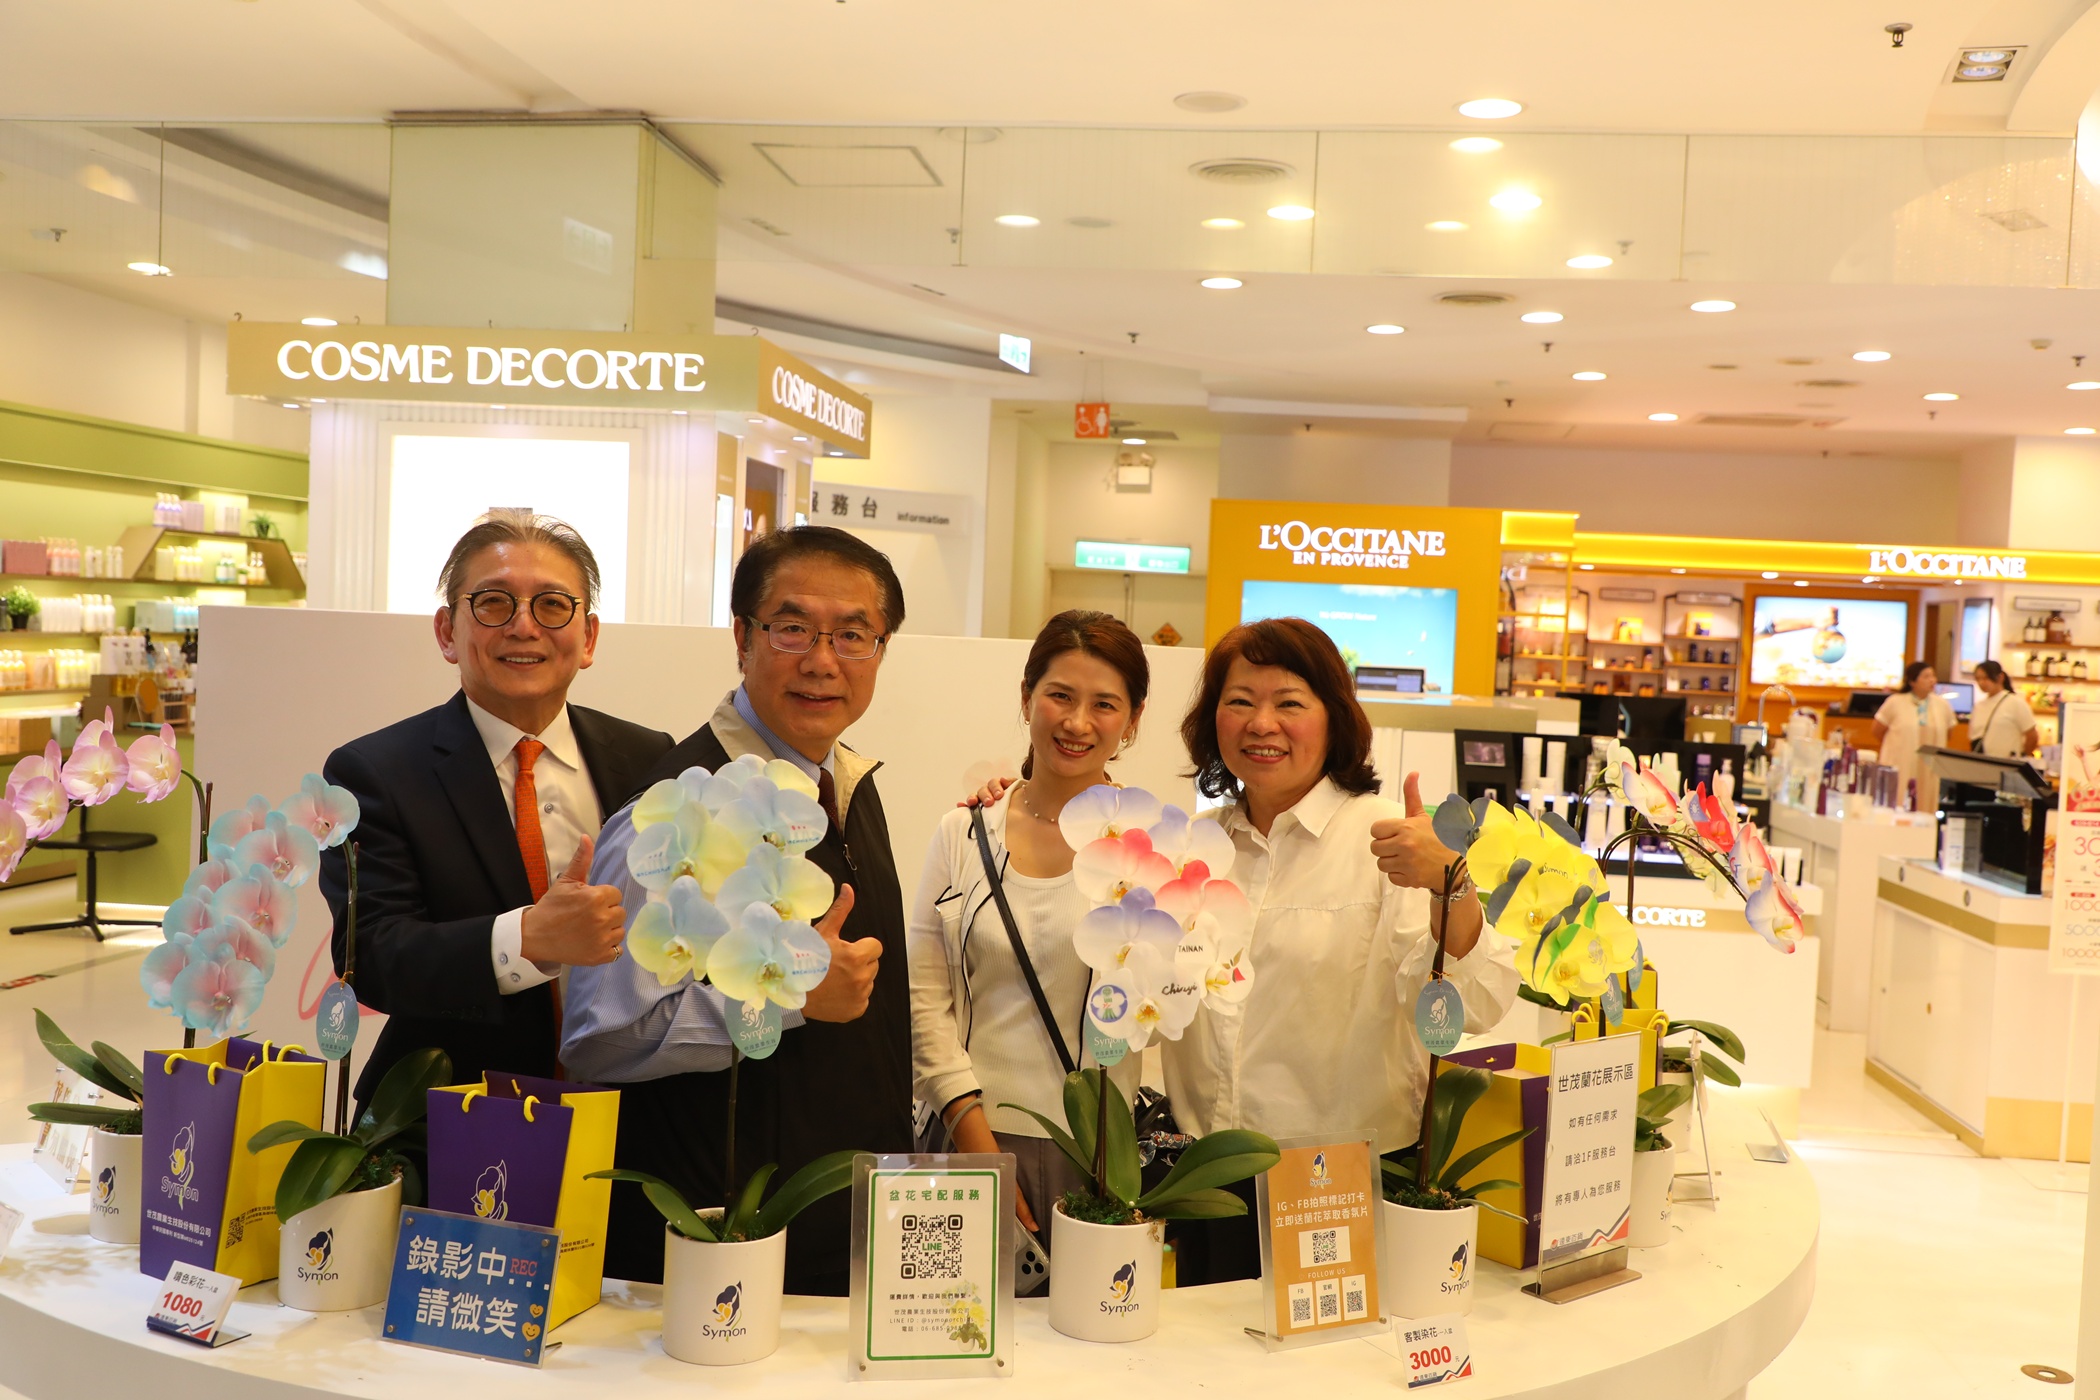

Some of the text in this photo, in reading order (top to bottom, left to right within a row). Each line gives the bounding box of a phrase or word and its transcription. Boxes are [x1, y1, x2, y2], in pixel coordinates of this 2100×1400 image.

[277, 340, 706, 392] COSME DECORTE
[772, 366, 865, 442] COSME DECORTE
[897, 511, 949, 525] information
[1259, 521, 1446, 556] L'OCCITANE
[1293, 551, 1409, 569] EN PROVENCE
[1869, 548, 2026, 578] L'OCCITANE
[322, 1028, 348, 1041] Symon
[740, 1026, 774, 1040] Symon
[1425, 1026, 1455, 1037] Symon
[1558, 1063, 1634, 1093] 世茂蘭花展示區
[1569, 1109, 1618, 1129] 如有任何需求
[1565, 1146, 1616, 1167] 請洽1F服務台
[161, 1176, 199, 1202] Symon
[1310, 1177, 1332, 1188] Symon
[889, 1189, 980, 1202] 盆花宅配服務
[1555, 1180, 1621, 1206] 將有專人為您服務
[92, 1198, 119, 1215] Symon
[1275, 1206, 1368, 1228] 立即送蘭花萃取香氛片
[922, 1242, 942, 1251] LINE
[298, 1266, 339, 1282] Symon
[510, 1258, 538, 1276] REC
[1308, 1267, 1346, 1279] FOLLOW US
[1441, 1280, 1469, 1294] Symon
[163, 1291, 203, 1318] 1080
[415, 1287, 519, 1339] 請微笑
[1100, 1301, 1139, 1315] Symon
[702, 1324, 746, 1340] Symon
[1410, 1346, 1452, 1370] 3000
